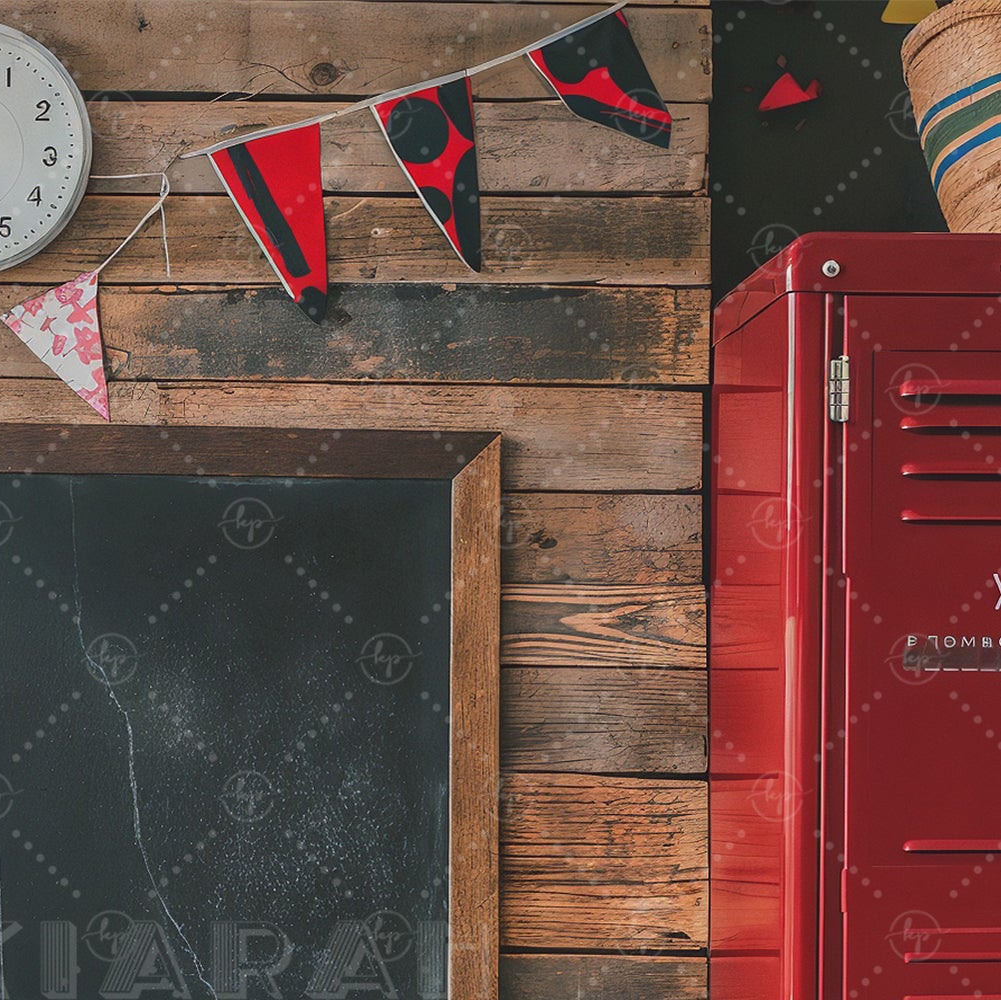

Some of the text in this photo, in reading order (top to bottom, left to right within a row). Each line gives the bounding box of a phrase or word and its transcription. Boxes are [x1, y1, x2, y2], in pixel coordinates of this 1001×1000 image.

[5, 66, 12, 87] 1
[35, 100, 51, 121] 2
[42, 146, 58, 167] 3
[26, 185, 43, 207] 4
